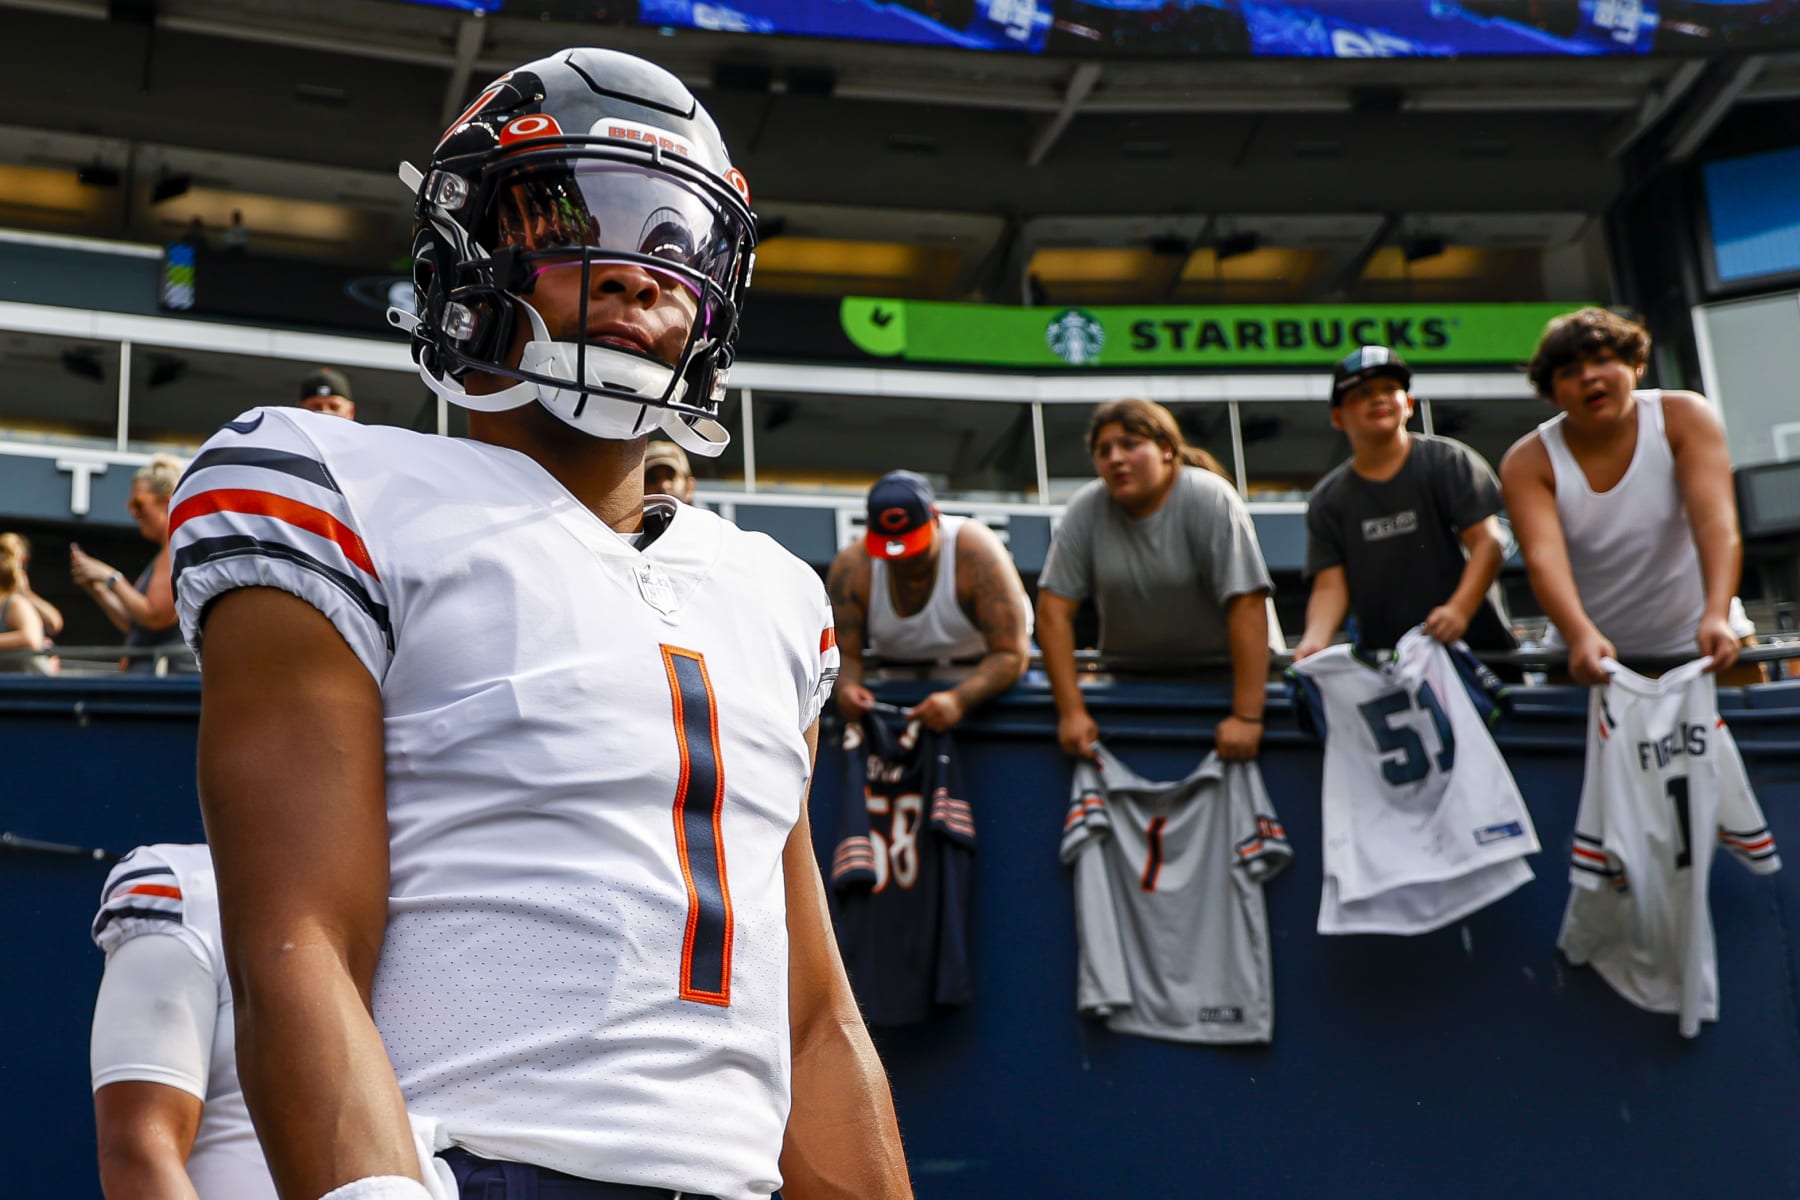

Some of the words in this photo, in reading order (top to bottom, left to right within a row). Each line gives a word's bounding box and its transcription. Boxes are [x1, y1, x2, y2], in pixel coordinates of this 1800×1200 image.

[608, 126, 688, 157] BEARS
[1129, 318, 1449, 350] STARBUCKS
[880, 507, 910, 532] C
[1356, 679, 1457, 788] 51
[659, 643, 734, 1007] 1
[863, 785, 924, 894] 58
[1140, 815, 1169, 893] 1
[1665, 775, 1693, 870] 1
